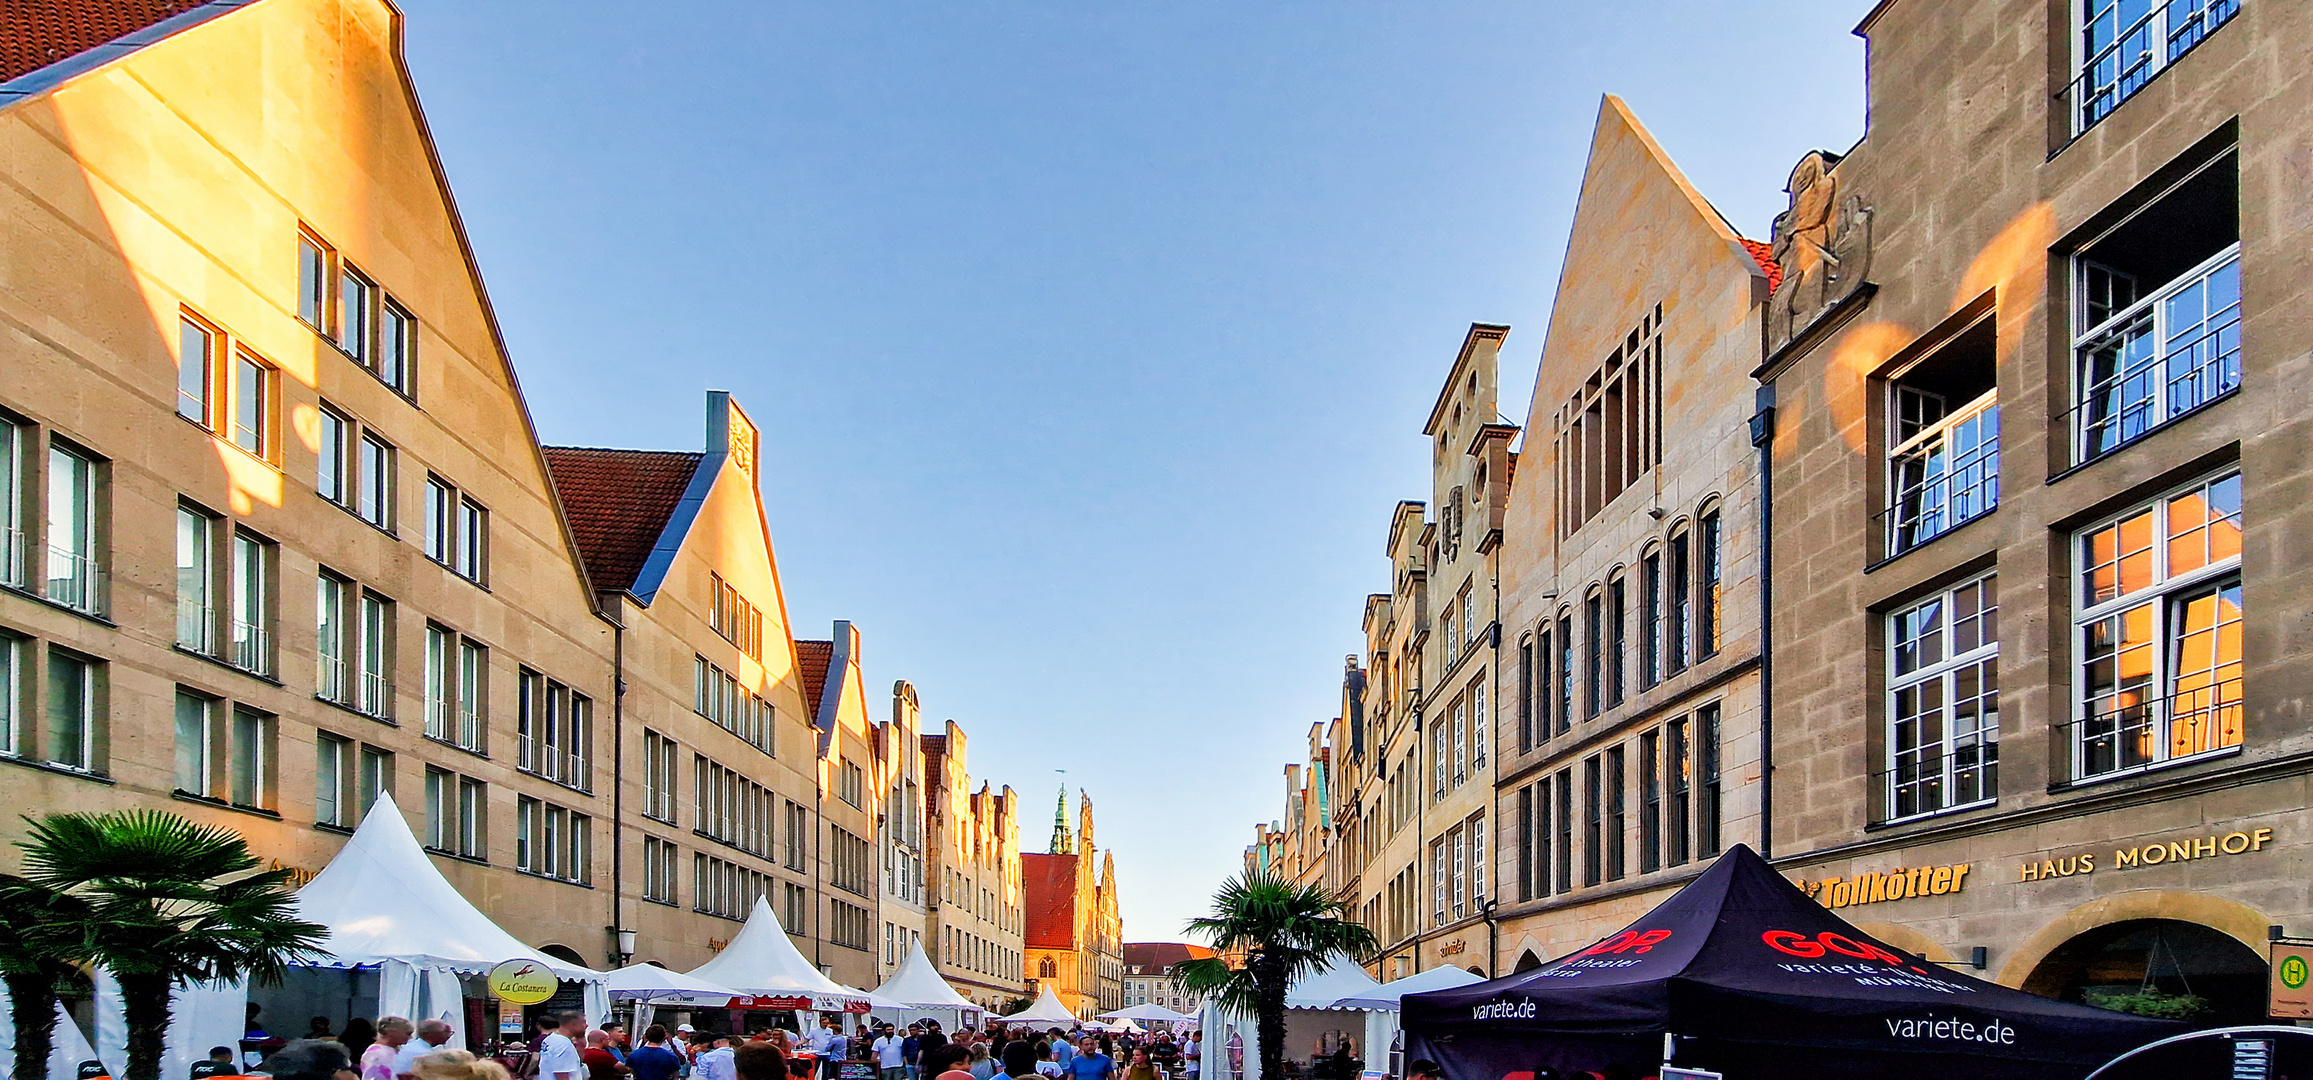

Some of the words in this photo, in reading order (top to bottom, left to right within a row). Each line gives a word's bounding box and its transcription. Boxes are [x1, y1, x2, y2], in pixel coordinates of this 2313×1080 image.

[2020, 854, 2095, 882] HAUS
[2115, 828, 2273, 869] MONHOF
[1820, 864, 1970, 909] Tollkötter
[499, 981, 511, 992] La
[512, 982, 547, 993] Costanera
[1473, 996, 1537, 1020] variete.de
[1886, 1012, 2015, 1045] variete.de
